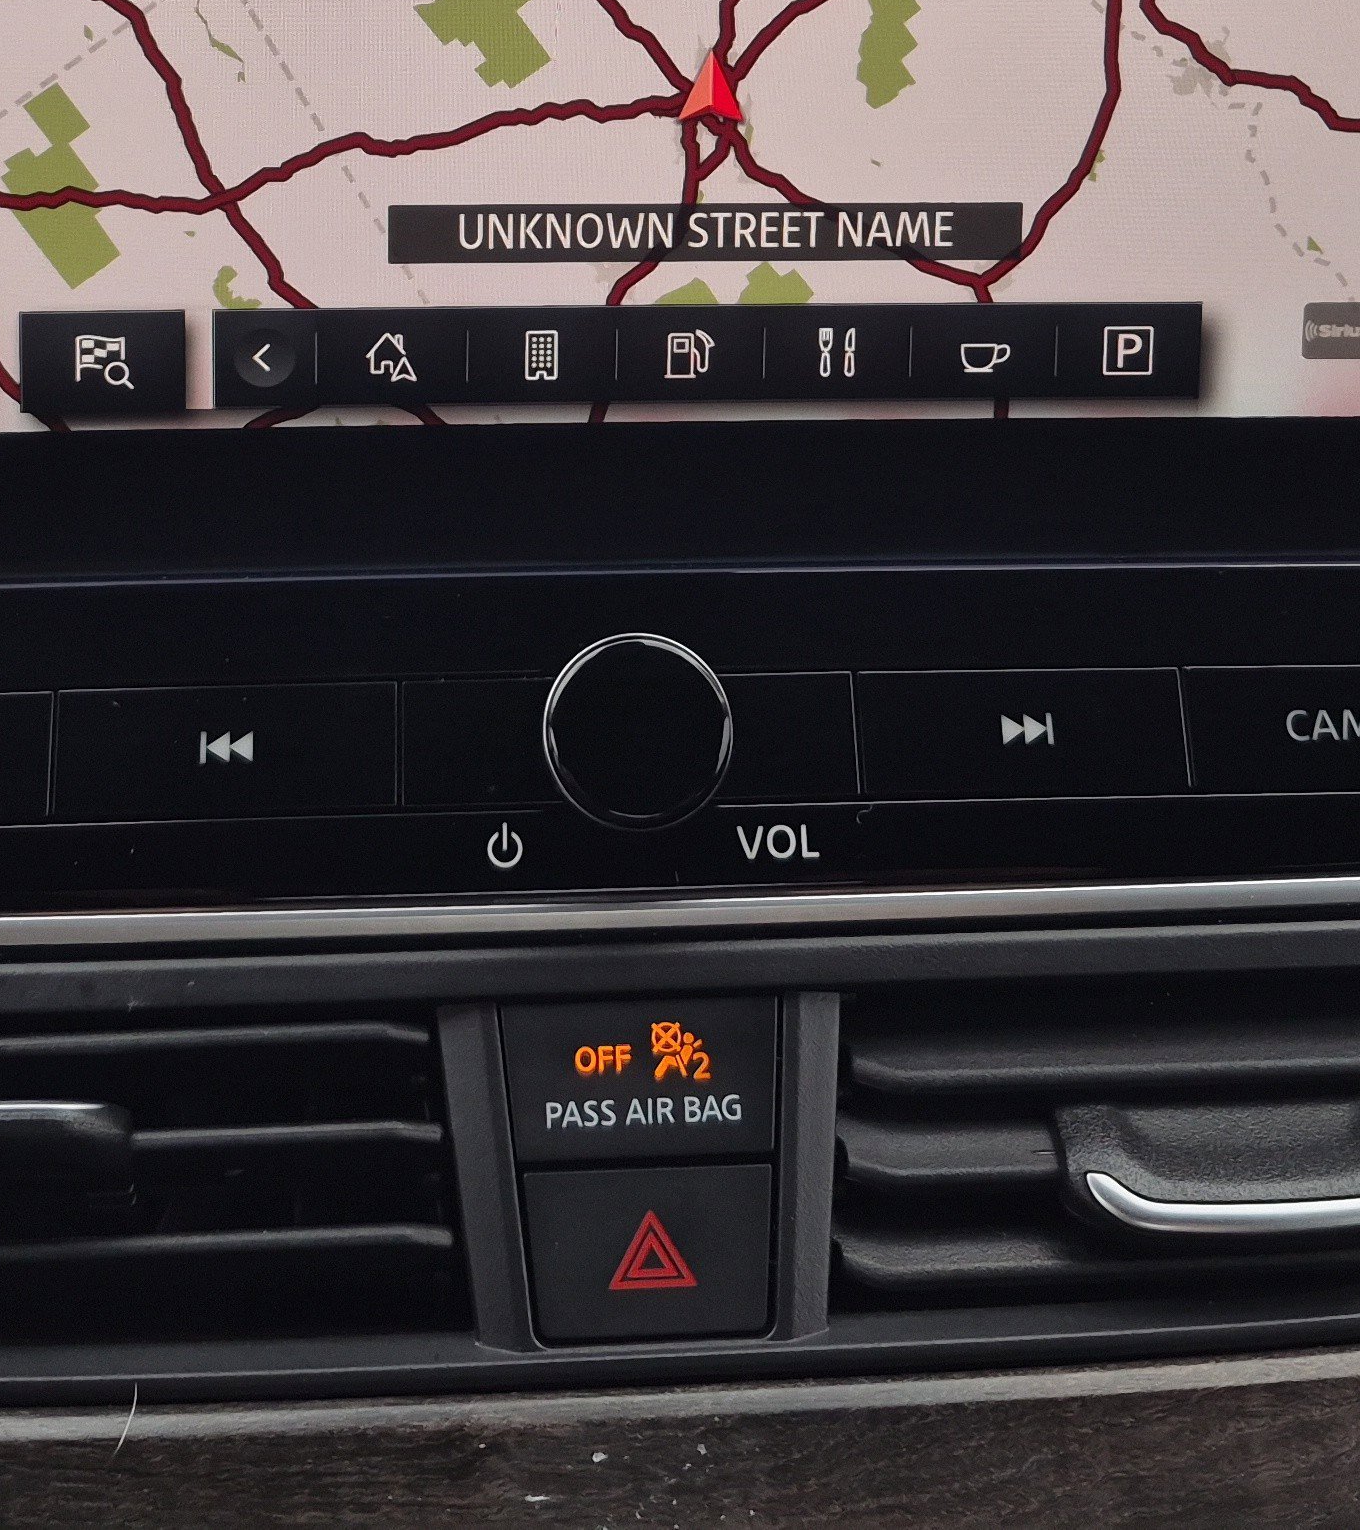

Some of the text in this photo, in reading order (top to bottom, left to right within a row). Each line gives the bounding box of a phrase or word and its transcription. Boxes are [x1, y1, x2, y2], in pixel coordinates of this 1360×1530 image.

[458, 210, 955, 250] UNKNOWN STREET NAME
[1115, 333, 1142, 369] P
[736, 823, 820, 861] VOL
[574, 1043, 712, 1080] OFF 2
[545, 1093, 742, 1130] PASS AIR BAG
